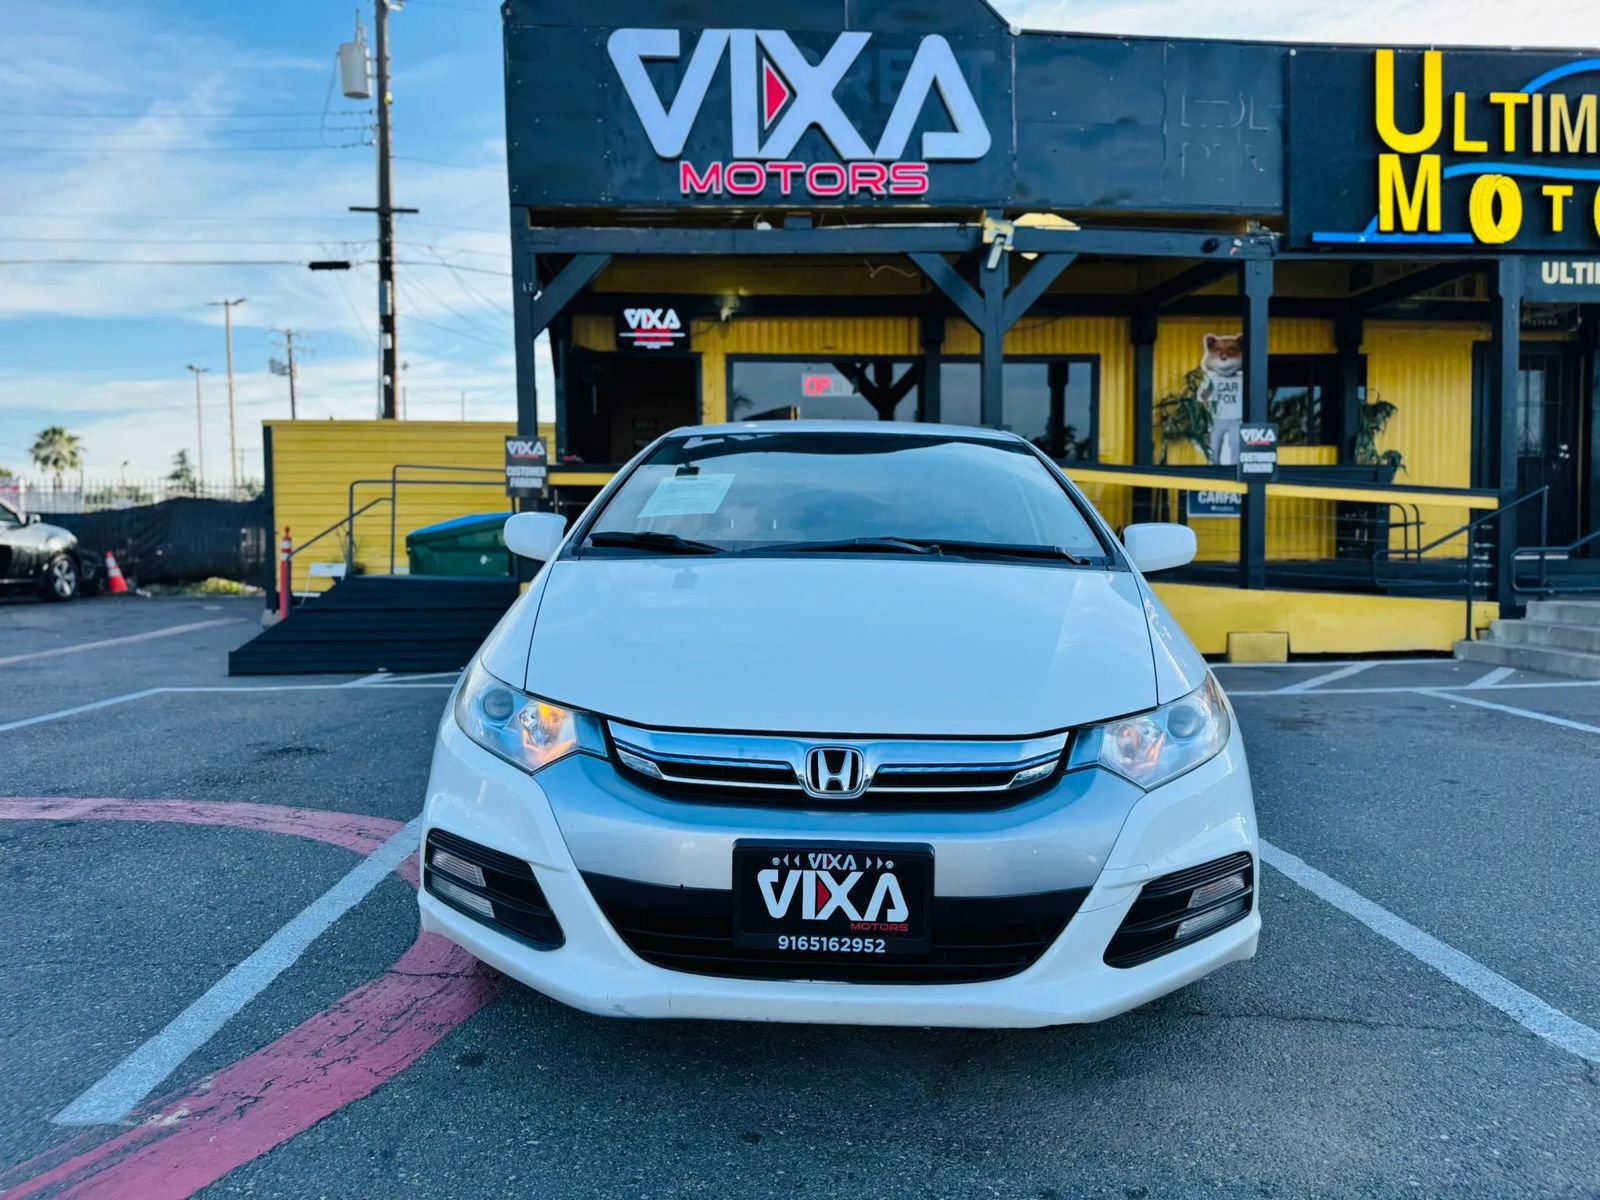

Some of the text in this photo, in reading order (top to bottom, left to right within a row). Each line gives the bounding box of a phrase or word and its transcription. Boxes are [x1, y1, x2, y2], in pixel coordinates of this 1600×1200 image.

[607, 28, 991, 161] VIXA
[1375, 48, 1600, 154] ULTIM
[679, 160, 929, 196] MOTORS
[1379, 153, 1600, 245] MOT
[1541, 260, 1600, 285] ULTI
[623, 307, 682, 330] VIXA
[1217, 381, 1239, 393] CAR
[1217, 393, 1238, 405] FOX
[1240, 428, 1276, 442] VIXA
[507, 440, 545, 455] VIXA
[808, 853, 857, 870] VIXA
[757, 868, 909, 923] VIXA
[850, 922, 909, 932] MOTORS
[778, 935, 886, 954] 9165162952
